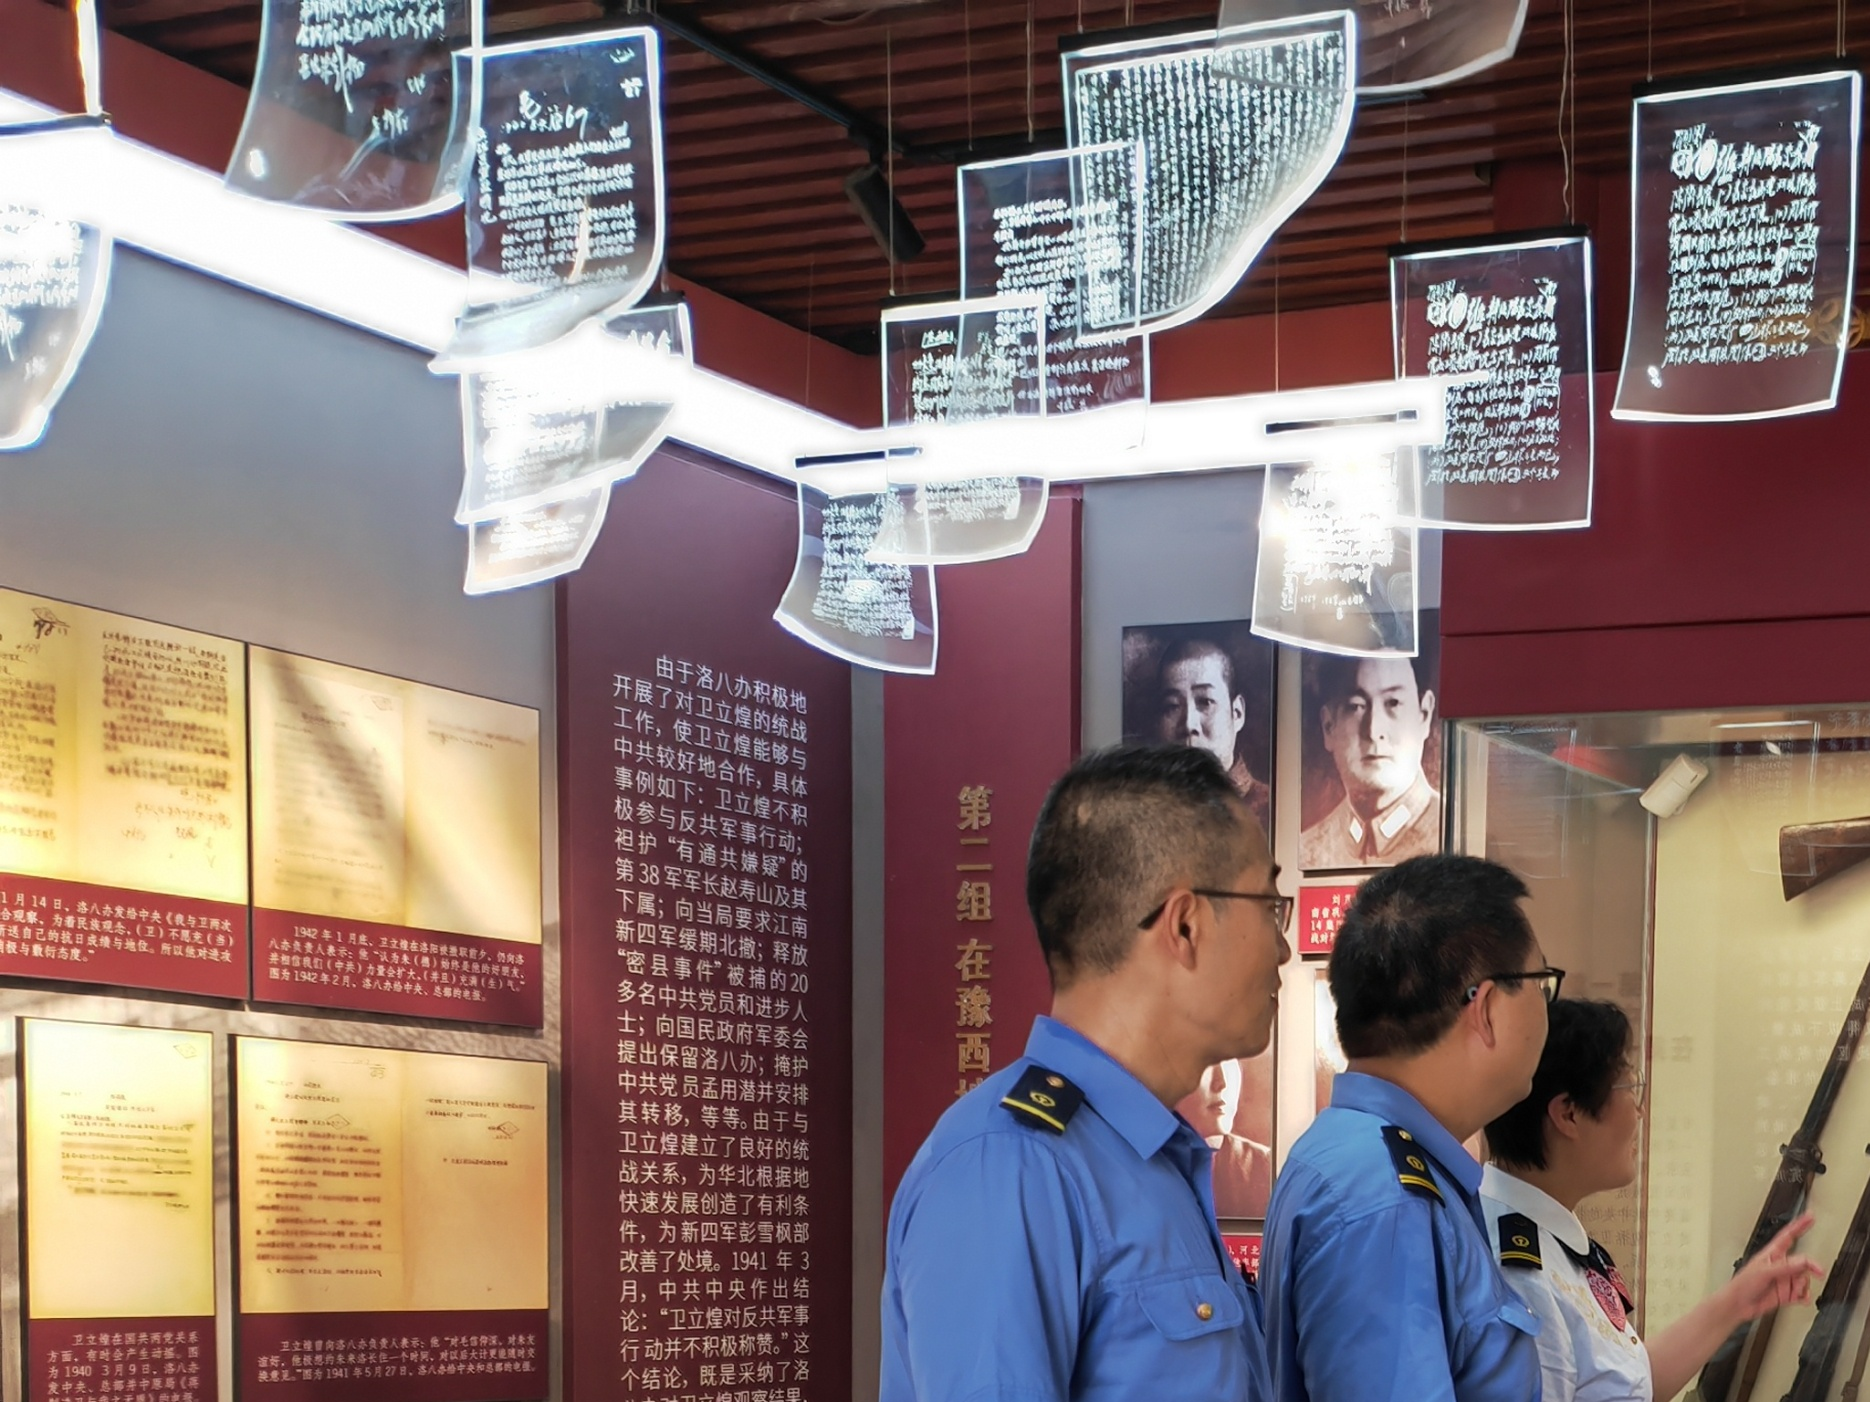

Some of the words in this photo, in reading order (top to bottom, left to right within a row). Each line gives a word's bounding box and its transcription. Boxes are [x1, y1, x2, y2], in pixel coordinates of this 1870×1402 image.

[656, 655, 807, 714] 由于洛八办积极地
[613, 675, 807, 743] 开展了对卫立煌的统战
[614, 707, 807, 771] 工作，使卫立煌能够与
[614, 737, 808, 797] 中共较好地合作，具体
[614, 767, 808, 827] 事例如下：卫立煌不积
[614, 796, 804, 855] 极参与反共军事行动；
[956, 785, 993, 921] 第二组
[616, 889, 808, 939] 下属；向当局要求江南
[615, 918, 808, 966] 新四军缓期北撤；释放
[617, 979, 808, 1022] 多名中共党员和进步人
[617, 1009, 808, 1050] 士；向国民政府军委会
[617, 1041, 809, 1078] 提出保留洛八办；掩护
[618, 1071, 809, 1105] 中共党员孟用潜并安排
[618, 1100, 808, 1133] 其转移，等等。由于与
[619, 1131, 809, 1161] 卫立煌建立了良好的统
[619, 1160, 809, 1188] 战关系，为华北根据地
[619, 1191, 809, 1216] 快速发展创造了有利条
[619, 1220, 809, 1245] 件，为新四军彭雪枫部
[620, 1278, 809, 1303] 月，中共中央作出结
[621, 1359, 809, 1391] 个结论，既是采纳了洛
